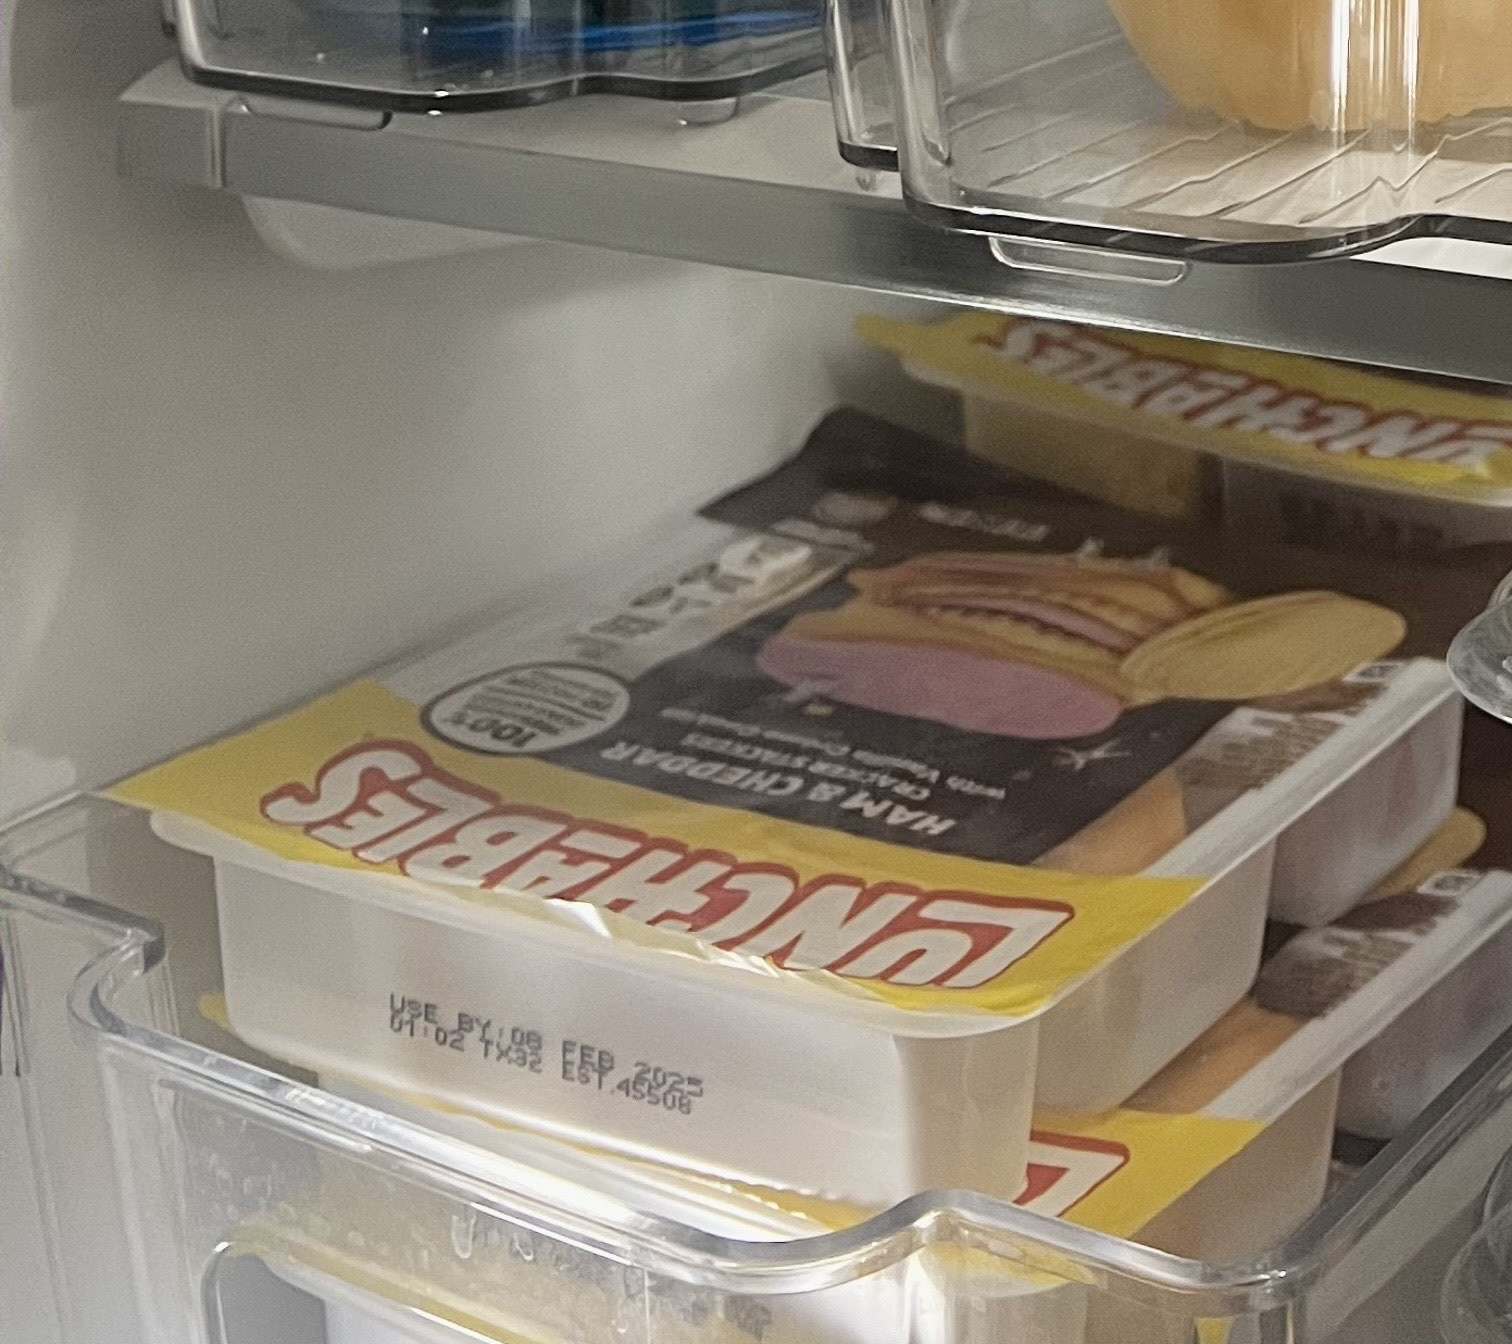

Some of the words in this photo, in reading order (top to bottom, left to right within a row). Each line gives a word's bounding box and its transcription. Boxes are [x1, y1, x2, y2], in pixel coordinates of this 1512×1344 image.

[603, 740, 804, 796] CHEDDAR
[807, 782, 846, 803] &
[809, 761, 931, 801] CRACKER
[840, 791, 957, 836] HAM
[260, 739, 1074, 989] LUNCHABLES
[390, 993, 438, 1025] USE
[562, 1040, 614, 1072] FEB
